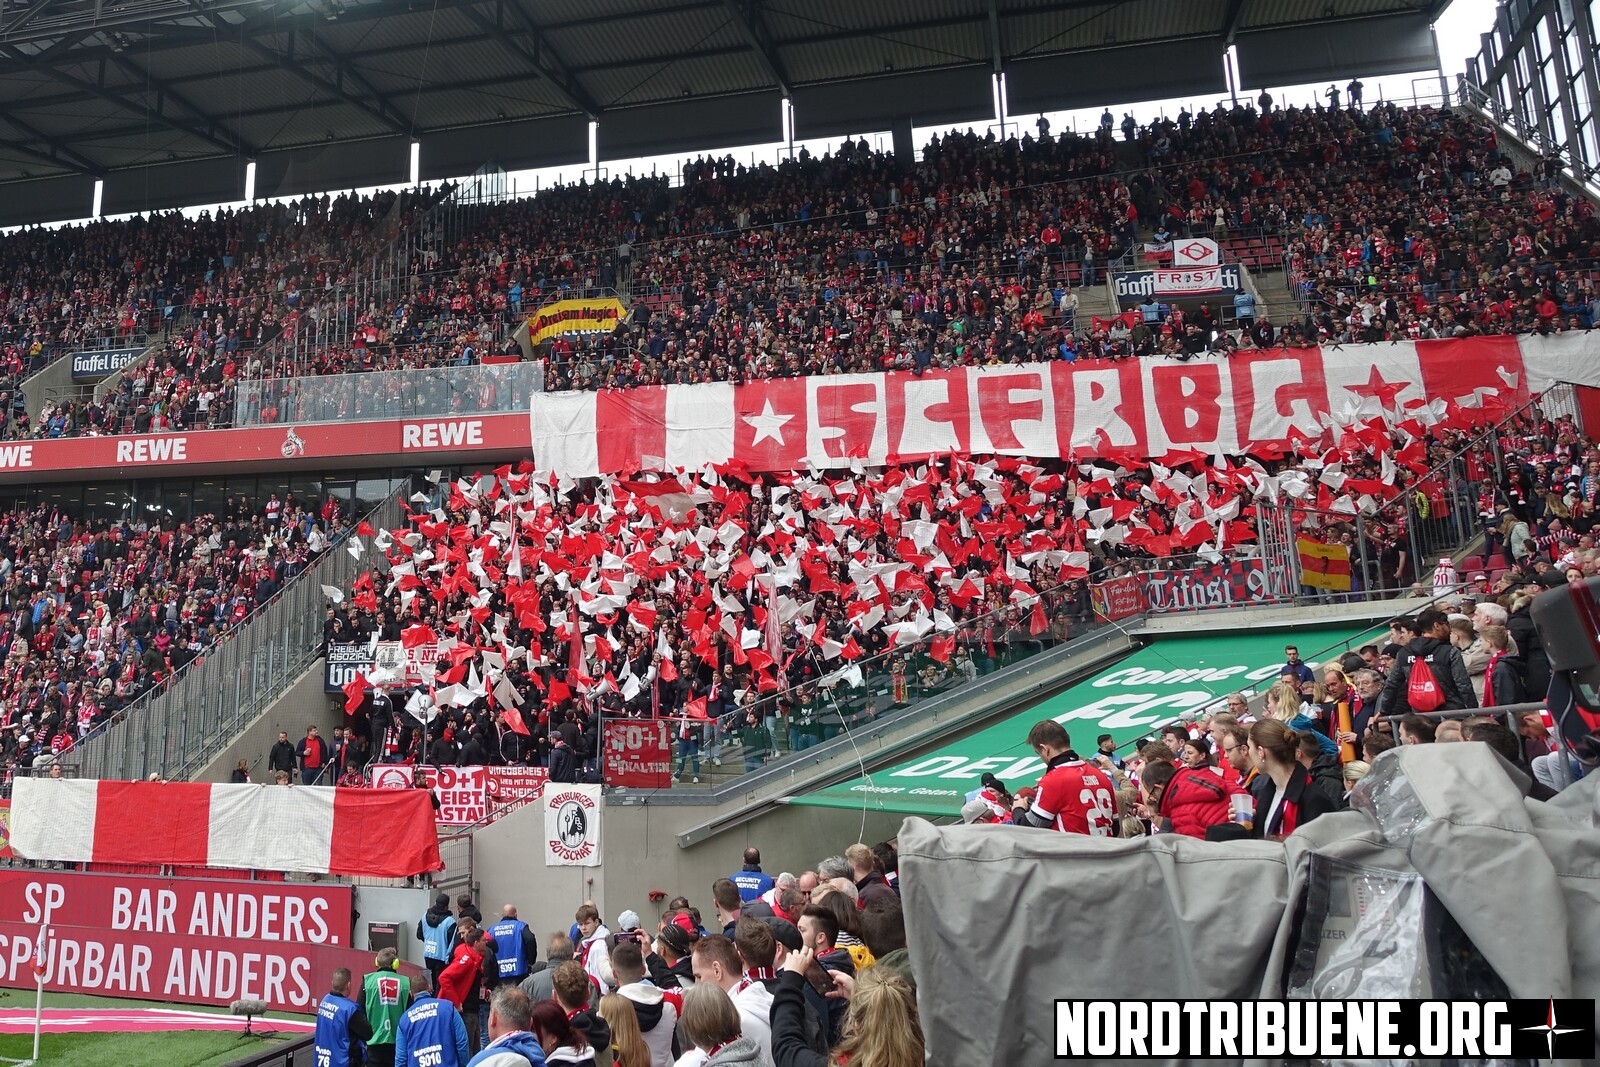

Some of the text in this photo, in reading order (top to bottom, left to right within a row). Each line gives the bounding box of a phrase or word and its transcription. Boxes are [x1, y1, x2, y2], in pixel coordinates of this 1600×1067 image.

[1114, 275, 1153, 296] Gaff
[73, 353, 109, 372] Gaffel
[402, 420, 484, 448] REWE
[0, 445, 33, 468] WE
[116, 437, 187, 463] REWE
[1434, 573, 1448, 586] 20
[329, 652, 371, 660] ASOZIAL
[1091, 665, 1249, 687] Come
[488, 767, 542, 776] VIDEOBEWEIS
[889, 756, 1048, 779] DEV
[423, 768, 485, 789] 50+1
[440, 791, 485, 806] EIBT.
[549, 792, 595, 809] FREIBURGER
[434, 807, 485, 821] ASTA!
[1079, 788, 1114, 836] 29
[549, 840, 595, 861] BOTSCHAFT
[735, 876, 762, 884] SECURITY
[736, 882, 759, 890] SERVICE
[111, 886, 178, 933] BAR
[188, 890, 340, 944] ANDERS.
[163, 946, 318, 1008] ANDERS.
[418, 1052, 442, 1067] S010
